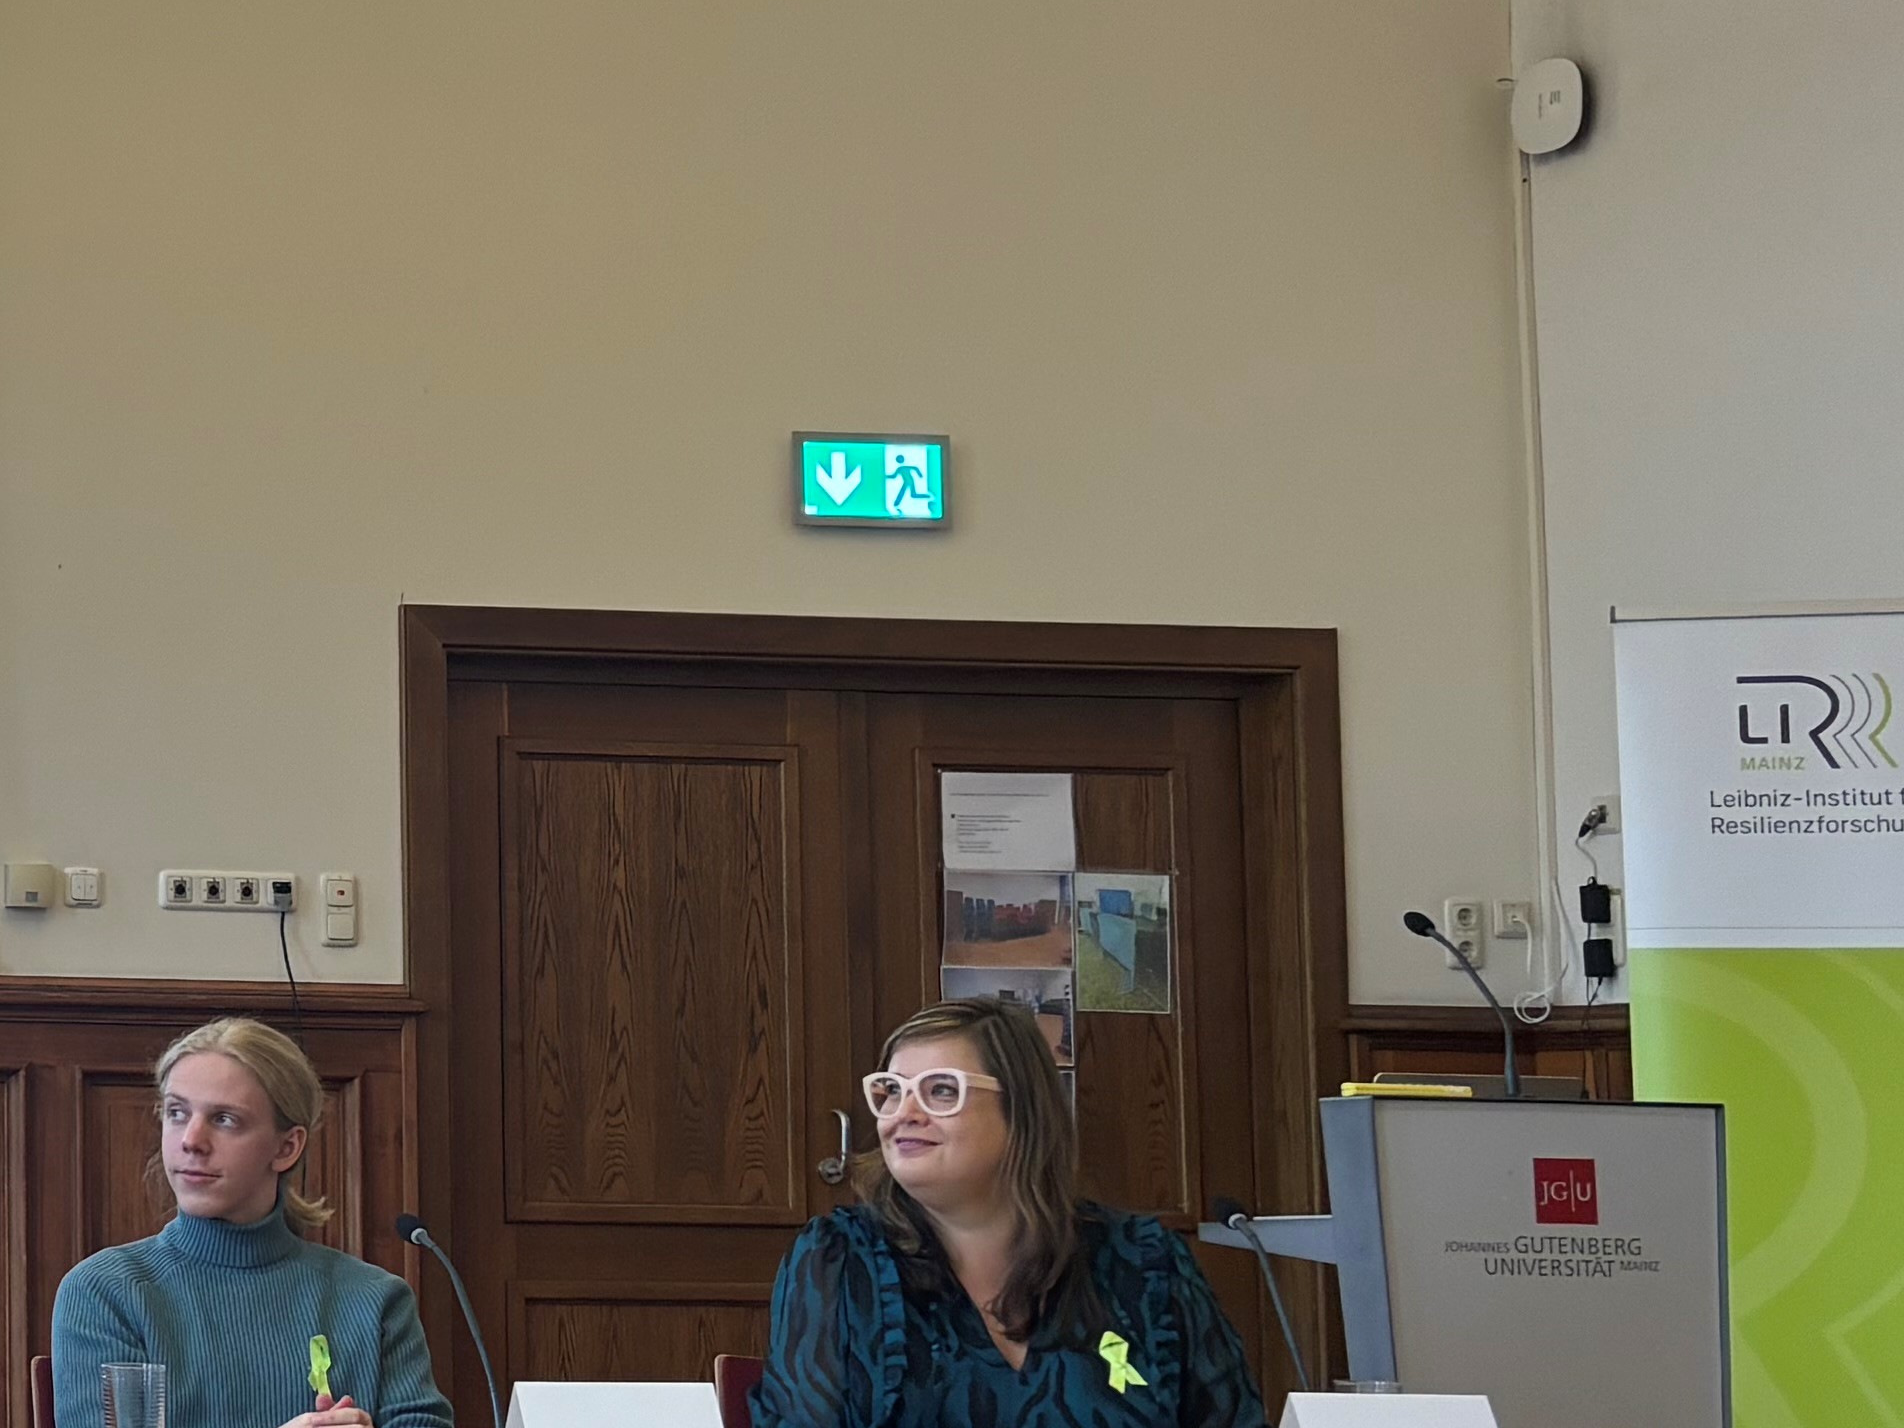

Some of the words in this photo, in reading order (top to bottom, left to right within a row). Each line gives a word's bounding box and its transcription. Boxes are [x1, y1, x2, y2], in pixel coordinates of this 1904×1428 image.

[1740, 756, 1806, 771] MAINZ
[1709, 787, 1893, 808] Leibniz-Institut
[1444, 1240, 1511, 1254] JOHANNES
[1513, 1235, 1643, 1257] GUTENBERG
[1483, 1257, 1616, 1278] UNIVERSITÄT
